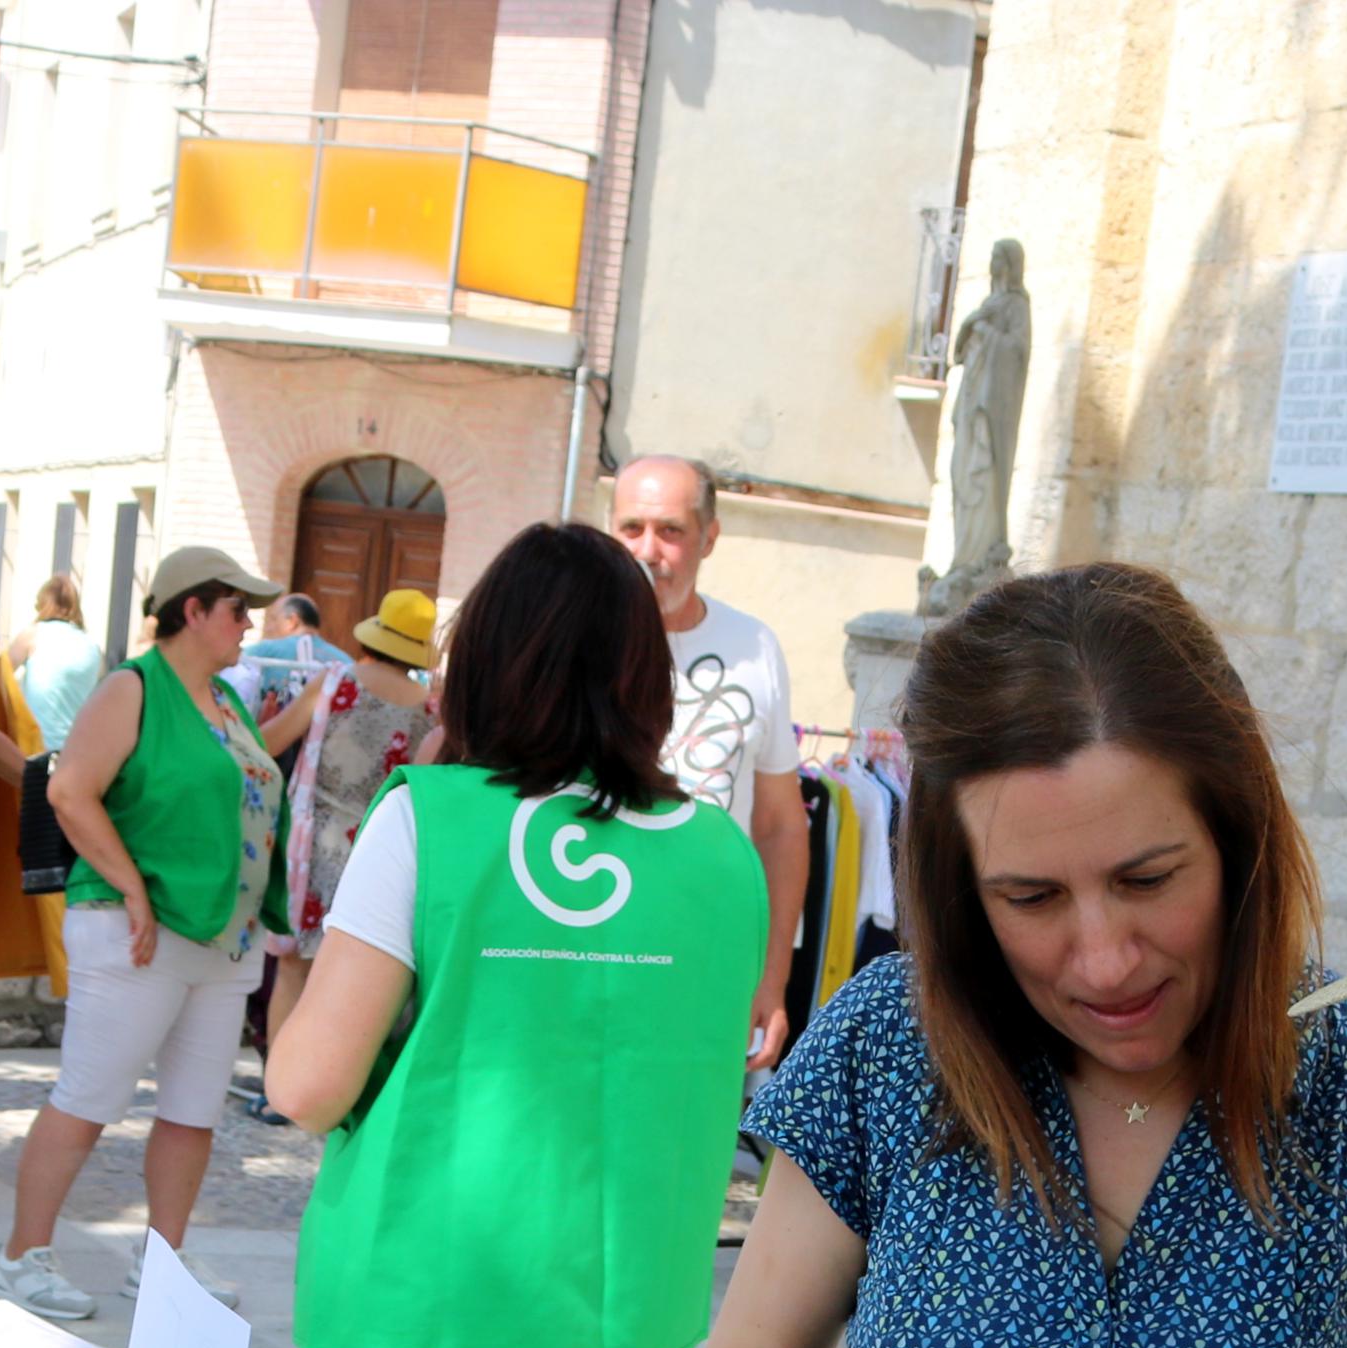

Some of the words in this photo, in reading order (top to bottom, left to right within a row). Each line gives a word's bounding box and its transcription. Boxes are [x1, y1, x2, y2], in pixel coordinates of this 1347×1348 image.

[356, 415, 379, 435] 14
[480, 948, 540, 959] ASOCIACIÓN
[542, 949, 586, 961] ESPAÑOLA
[587, 952, 624, 963] CONTRA
[624, 954, 636, 964] EL
[636, 953, 673, 965] CÁNCER
